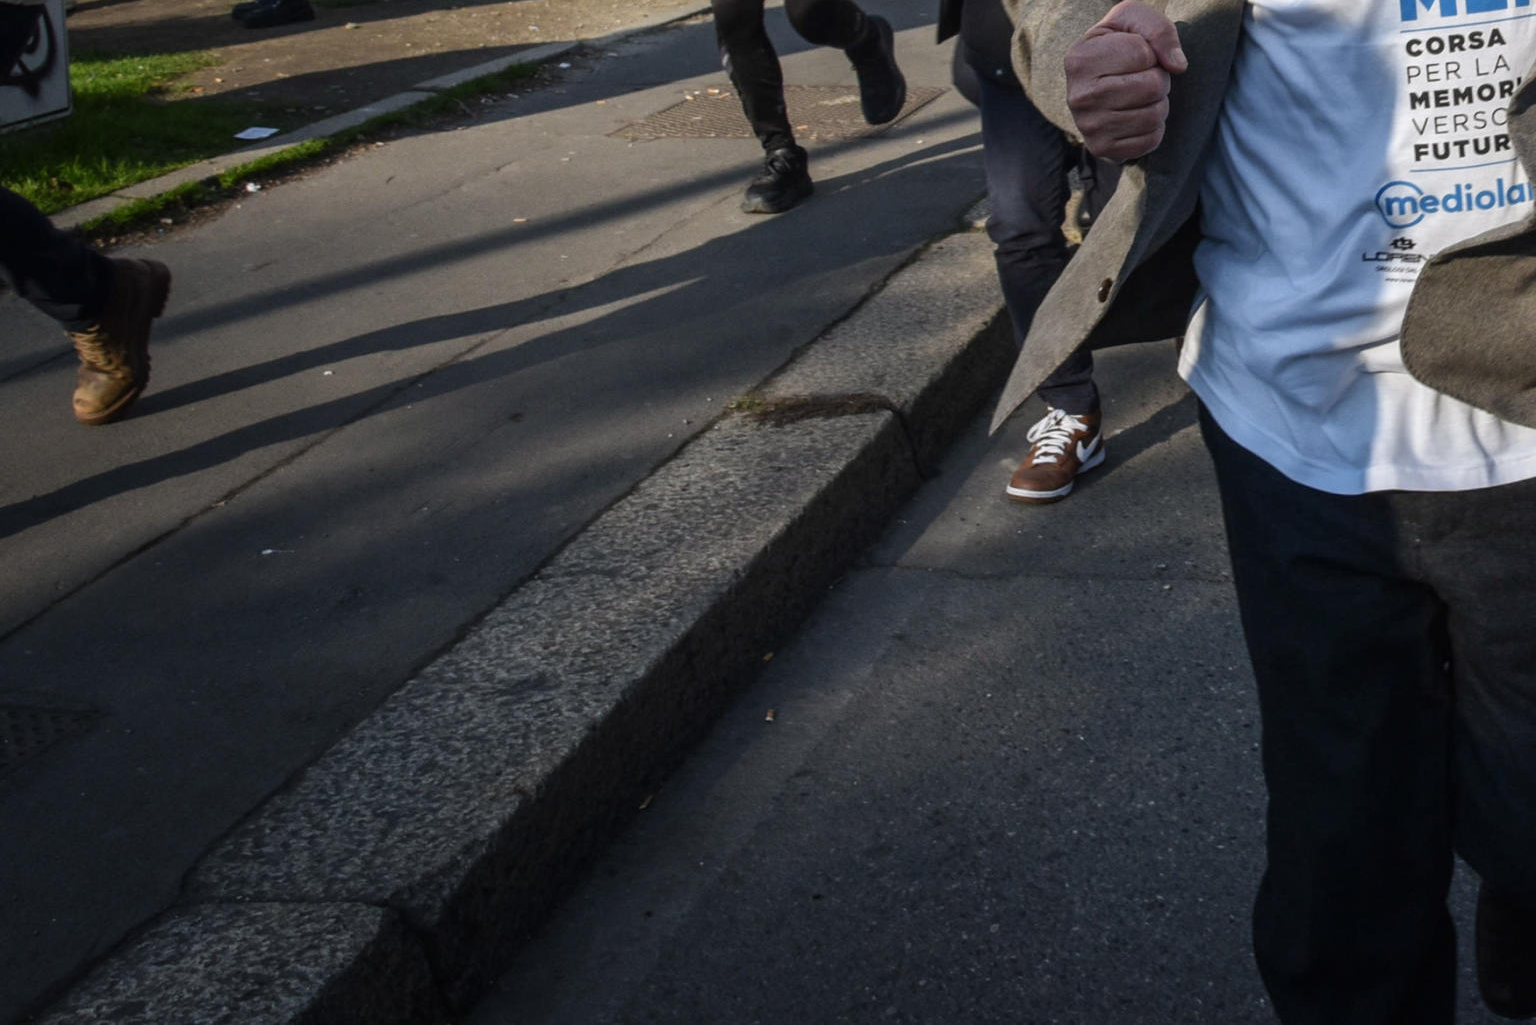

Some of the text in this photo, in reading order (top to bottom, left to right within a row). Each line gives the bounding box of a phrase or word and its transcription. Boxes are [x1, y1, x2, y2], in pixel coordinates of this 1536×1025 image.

[1406, 28, 1506, 57] CORSA
[1406, 54, 1511, 84] PER LA
